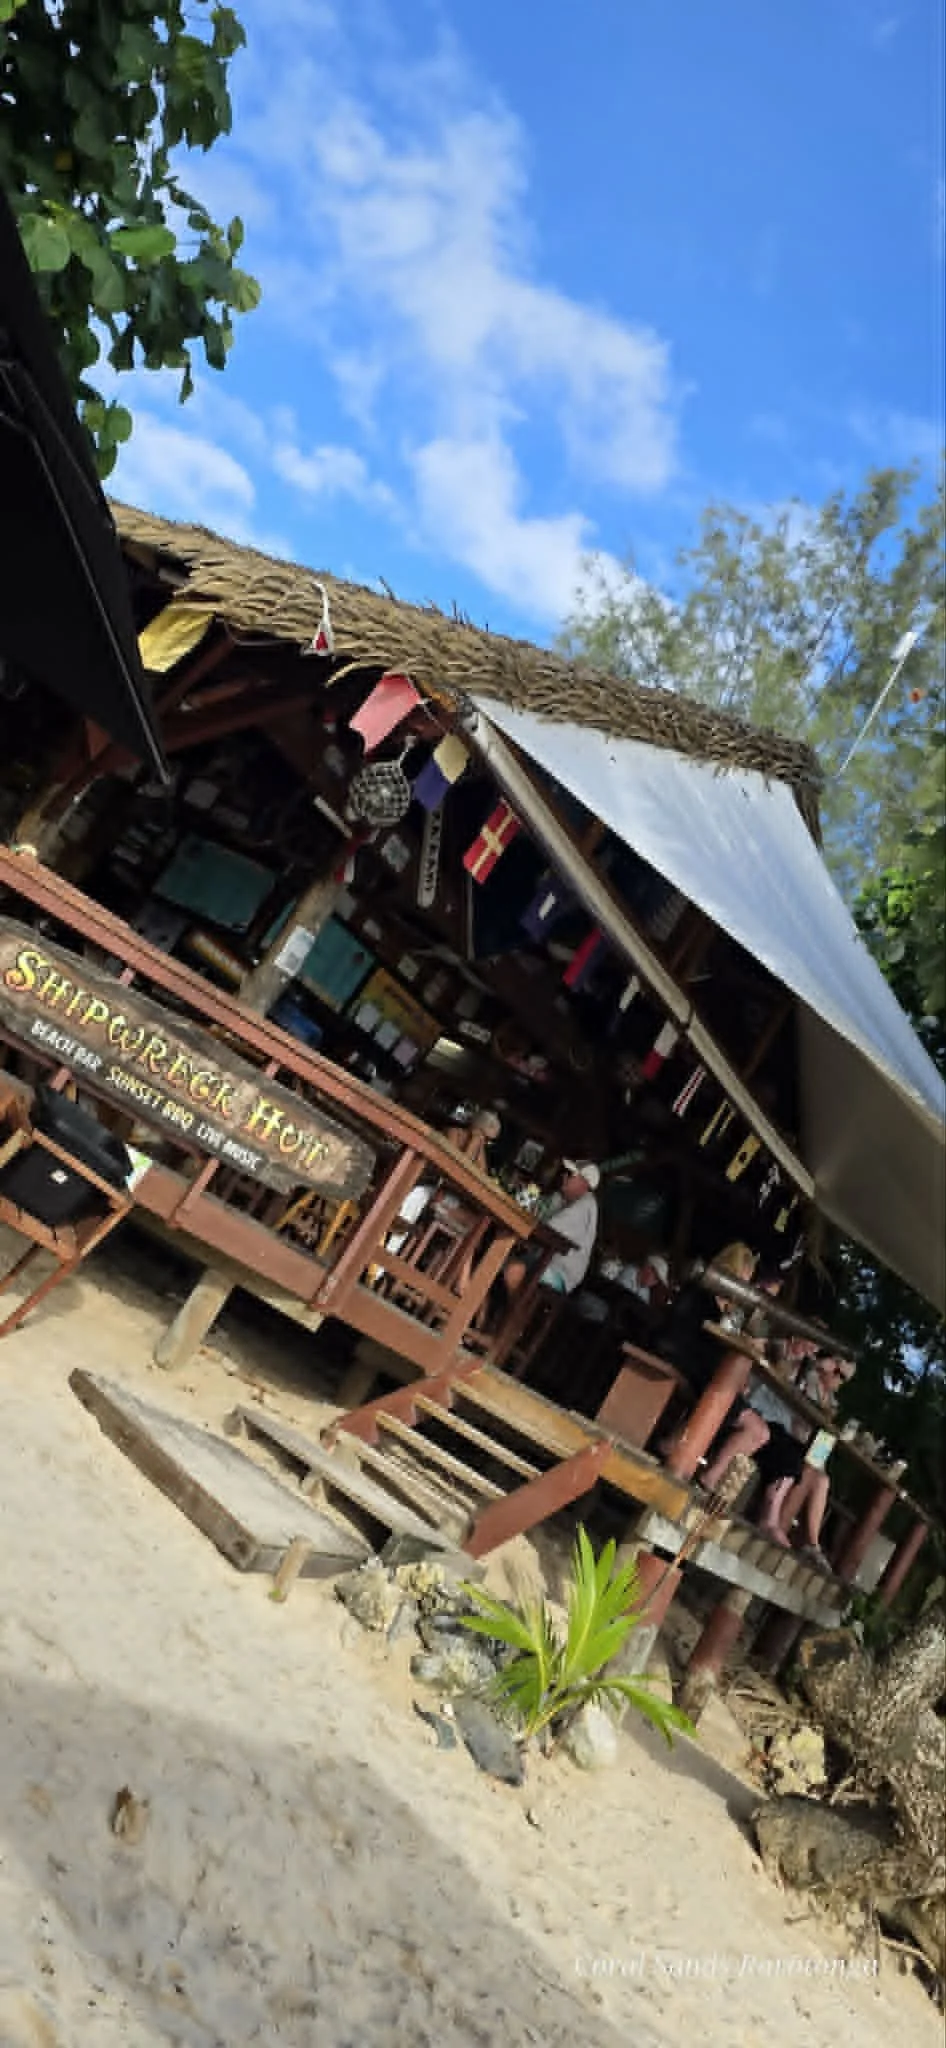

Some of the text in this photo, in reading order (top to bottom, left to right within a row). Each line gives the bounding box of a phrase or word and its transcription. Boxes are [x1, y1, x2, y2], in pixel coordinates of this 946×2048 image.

[4, 950, 237, 1119] SHIPWRECK
[245, 1097, 329, 1169] HUT
[31, 1019, 263, 1170] BEACH BAR SUNSET BBQ LIVE MUSIC
